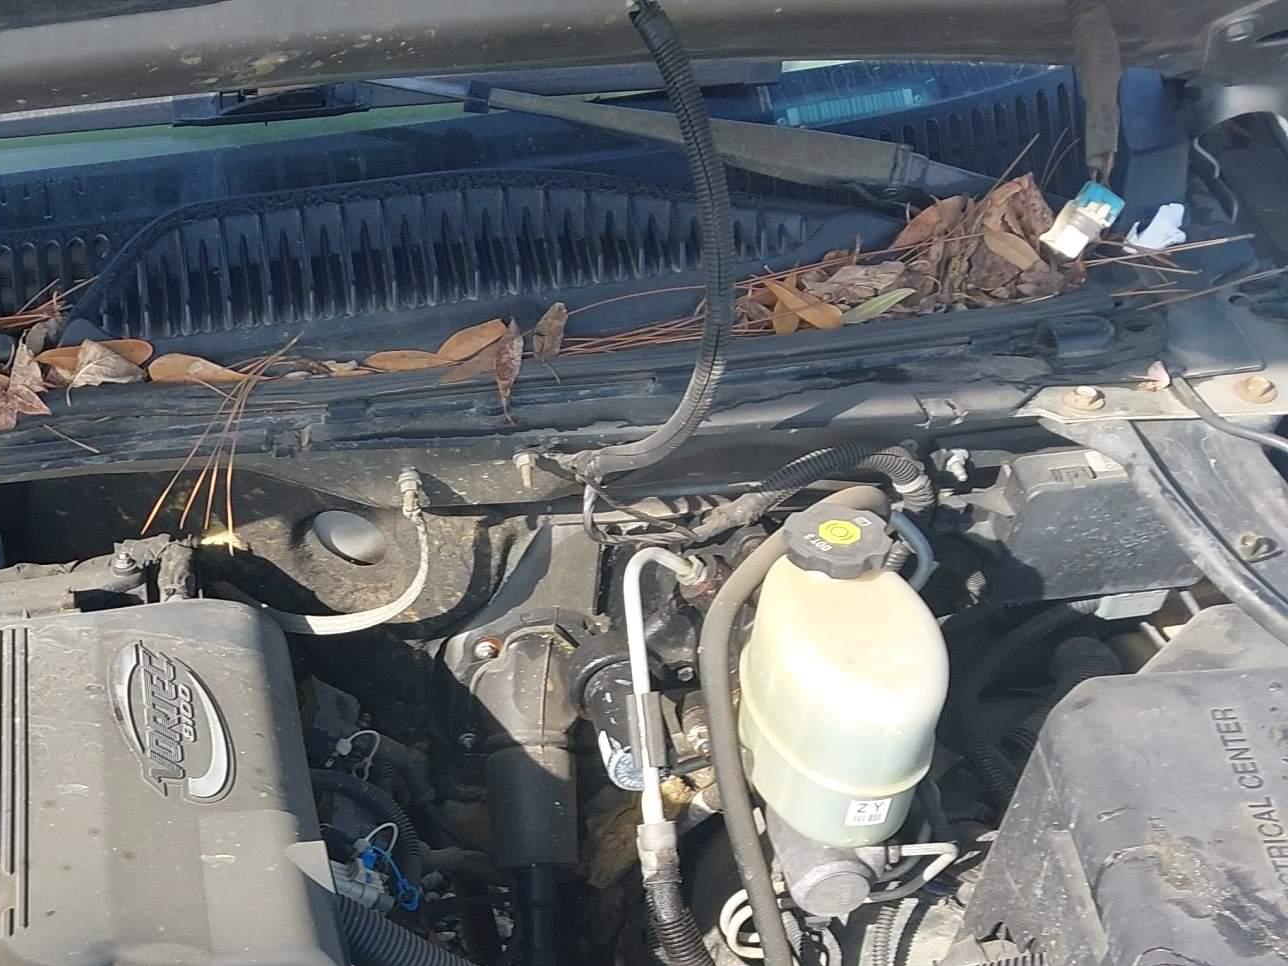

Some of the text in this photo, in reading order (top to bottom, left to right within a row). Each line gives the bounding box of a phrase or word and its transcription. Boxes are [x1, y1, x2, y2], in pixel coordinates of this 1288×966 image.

[136, 640, 187, 797] VORTEC
[178, 683, 197, 743] 8100
[1210, 707, 1264, 789] CENTER
